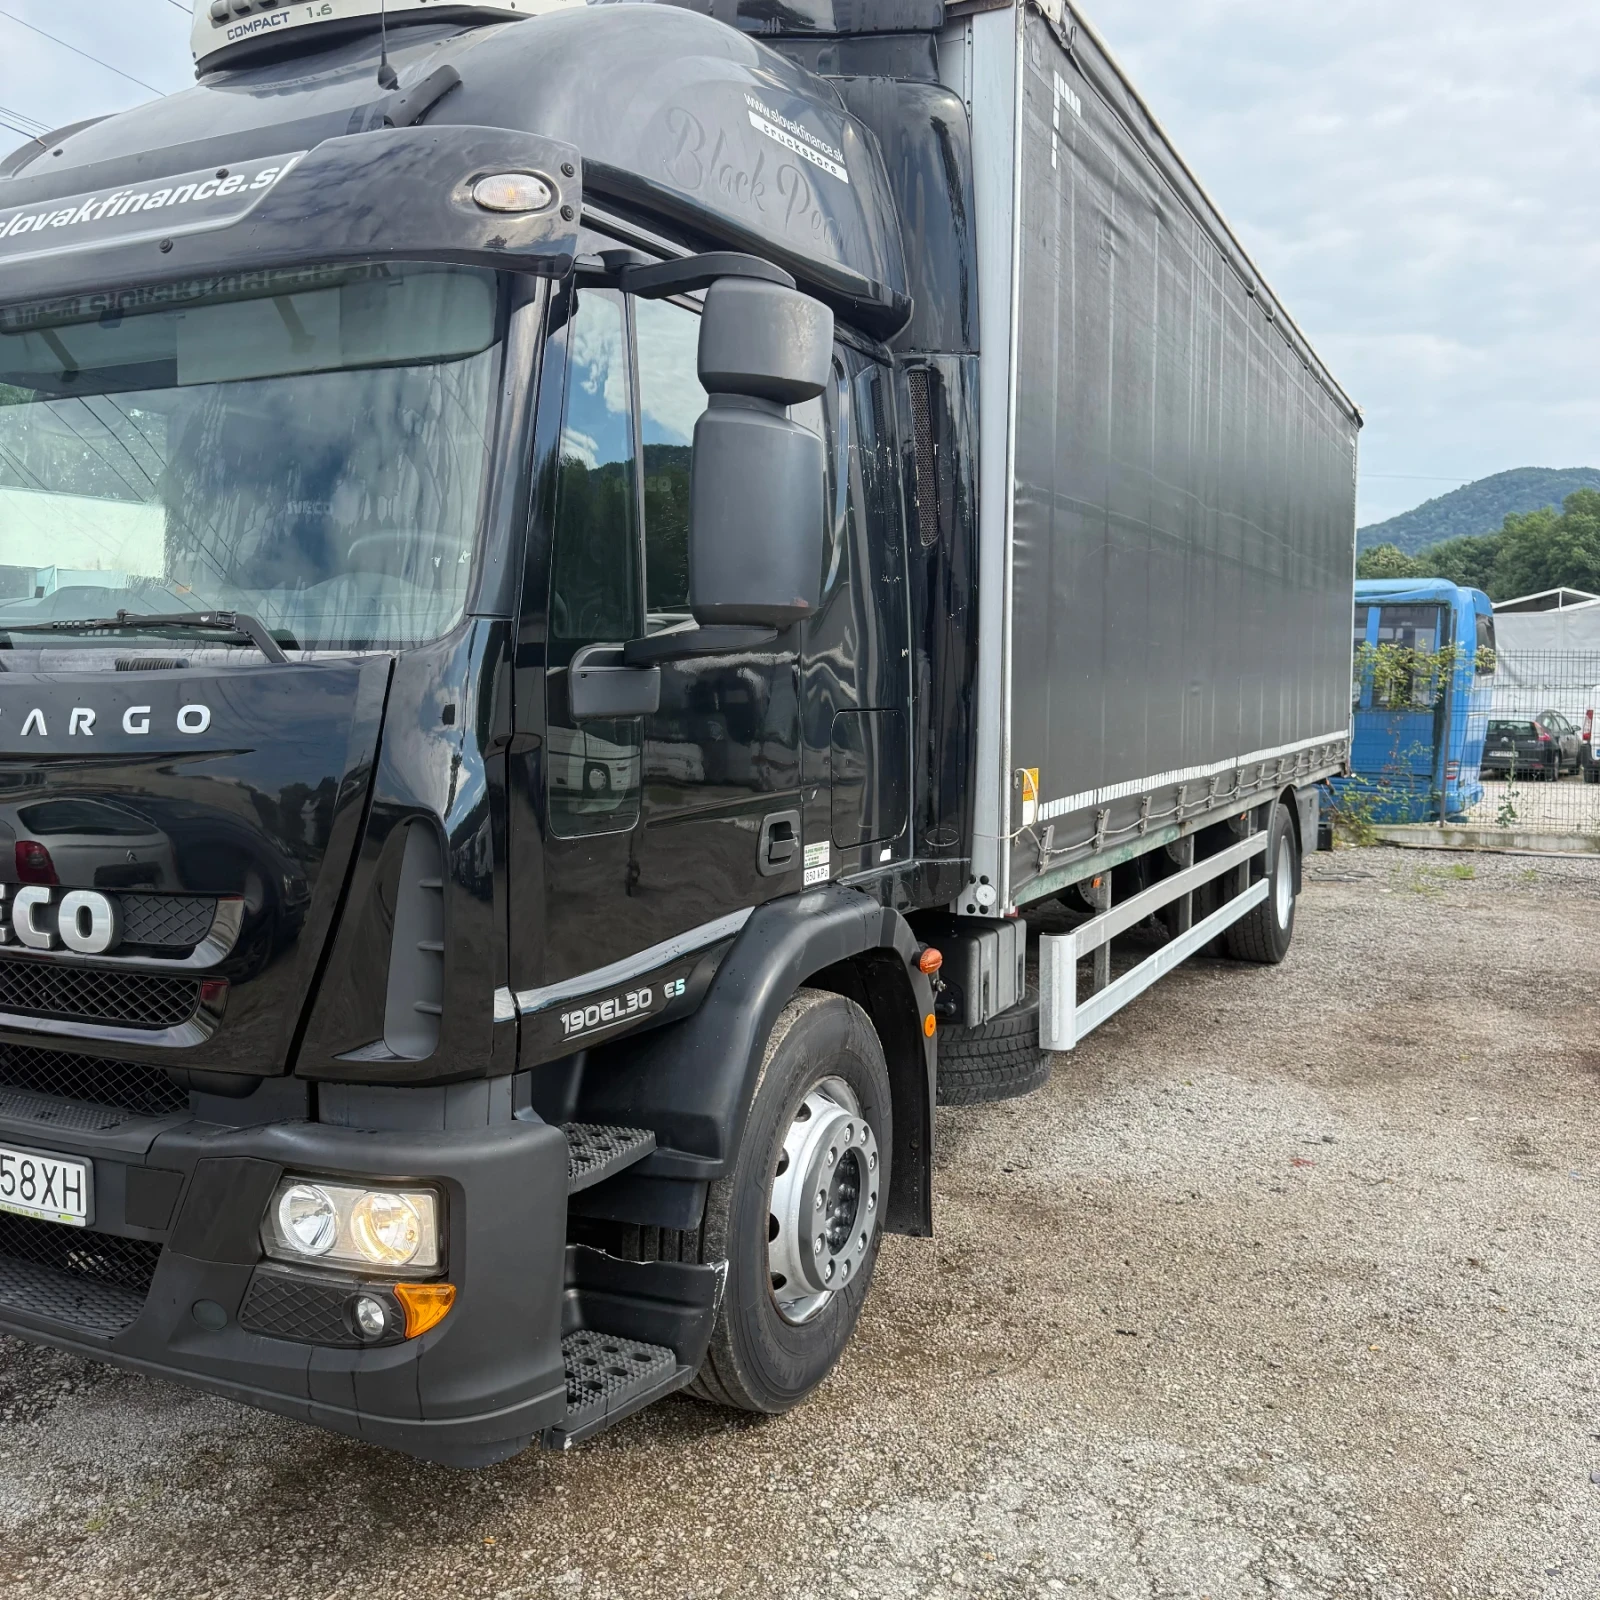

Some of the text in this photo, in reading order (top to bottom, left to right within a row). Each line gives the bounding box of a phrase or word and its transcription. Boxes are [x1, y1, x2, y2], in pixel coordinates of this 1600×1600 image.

[227, 3, 333, 40] COMPACT 1.6
[664, 106, 766, 212] Black
[763, 123, 838, 175] truckstore
[0, 155, 299, 238] lovakfinance.s
[0, 704, 211, 736] ARGO
[0, 883, 113, 954] CO
[559, 978, 686, 1035] 190EL30 E5
[0, 1154, 82, 1213] 58XH
